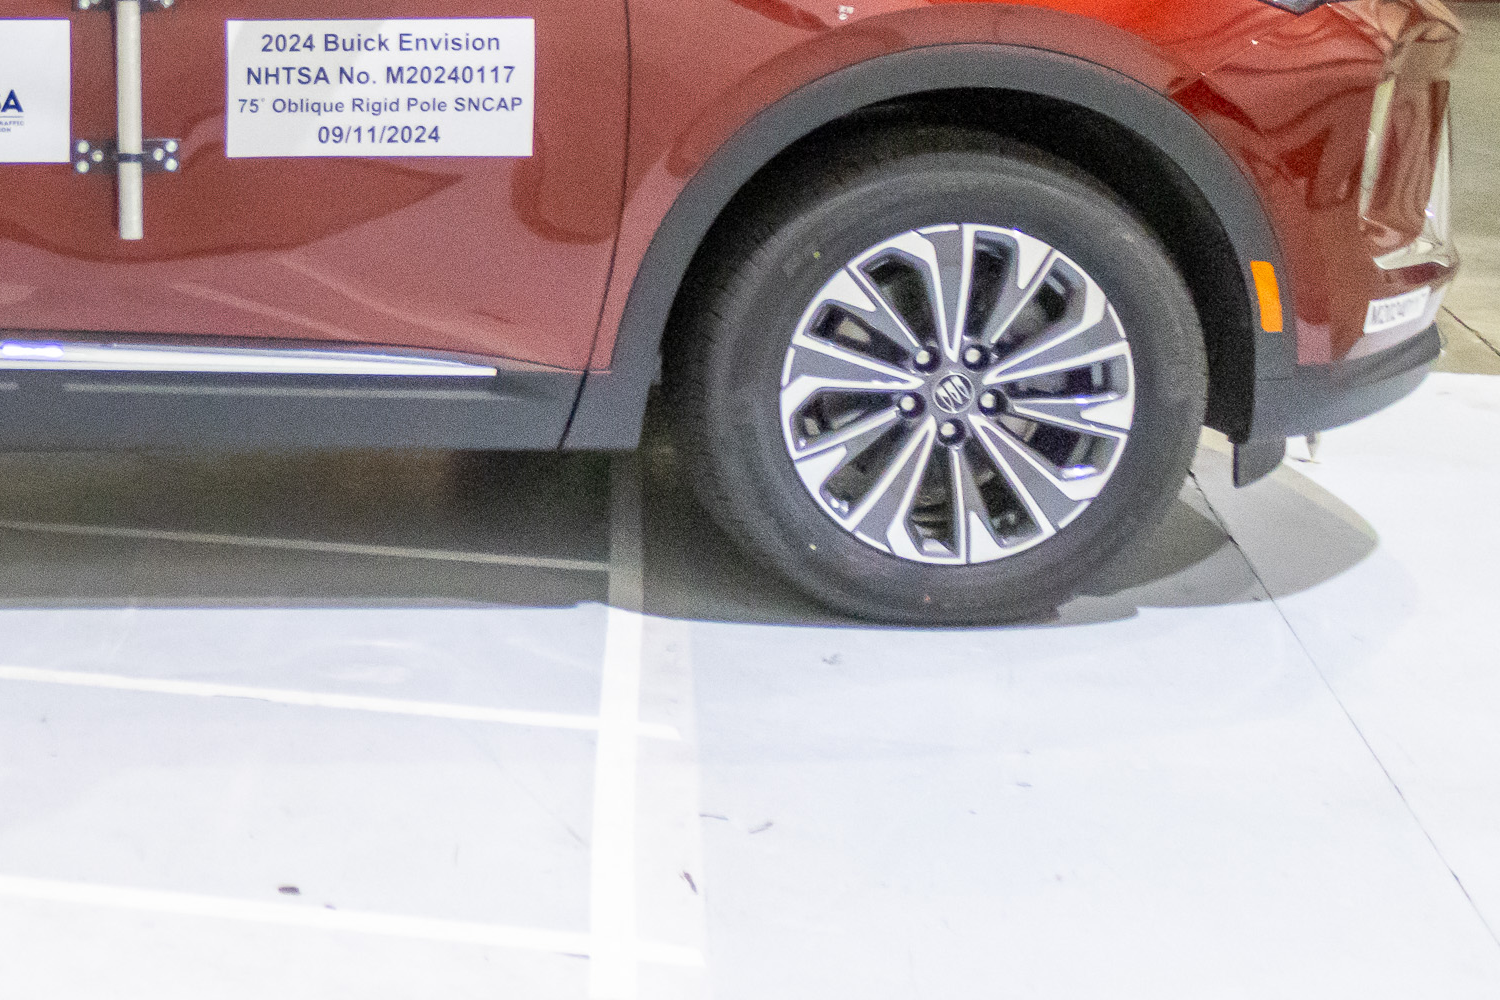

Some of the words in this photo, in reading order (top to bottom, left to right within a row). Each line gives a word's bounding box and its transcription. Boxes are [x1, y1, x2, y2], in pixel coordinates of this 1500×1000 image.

[261, 34, 315, 52] 2024
[324, 33, 390, 52] Buick
[399, 33, 500, 51] Envision
[247, 66, 330, 85] NHTSA
[339, 66, 376, 85] No.
[387, 65, 516, 84] M20240117
[272, 97, 344, 116] Oblique
[352, 97, 400, 115] Rigid
[407, 97, 447, 112] Pole
[454, 97, 522, 112] SNCAP
[318, 125, 441, 144] 09/11/2024
